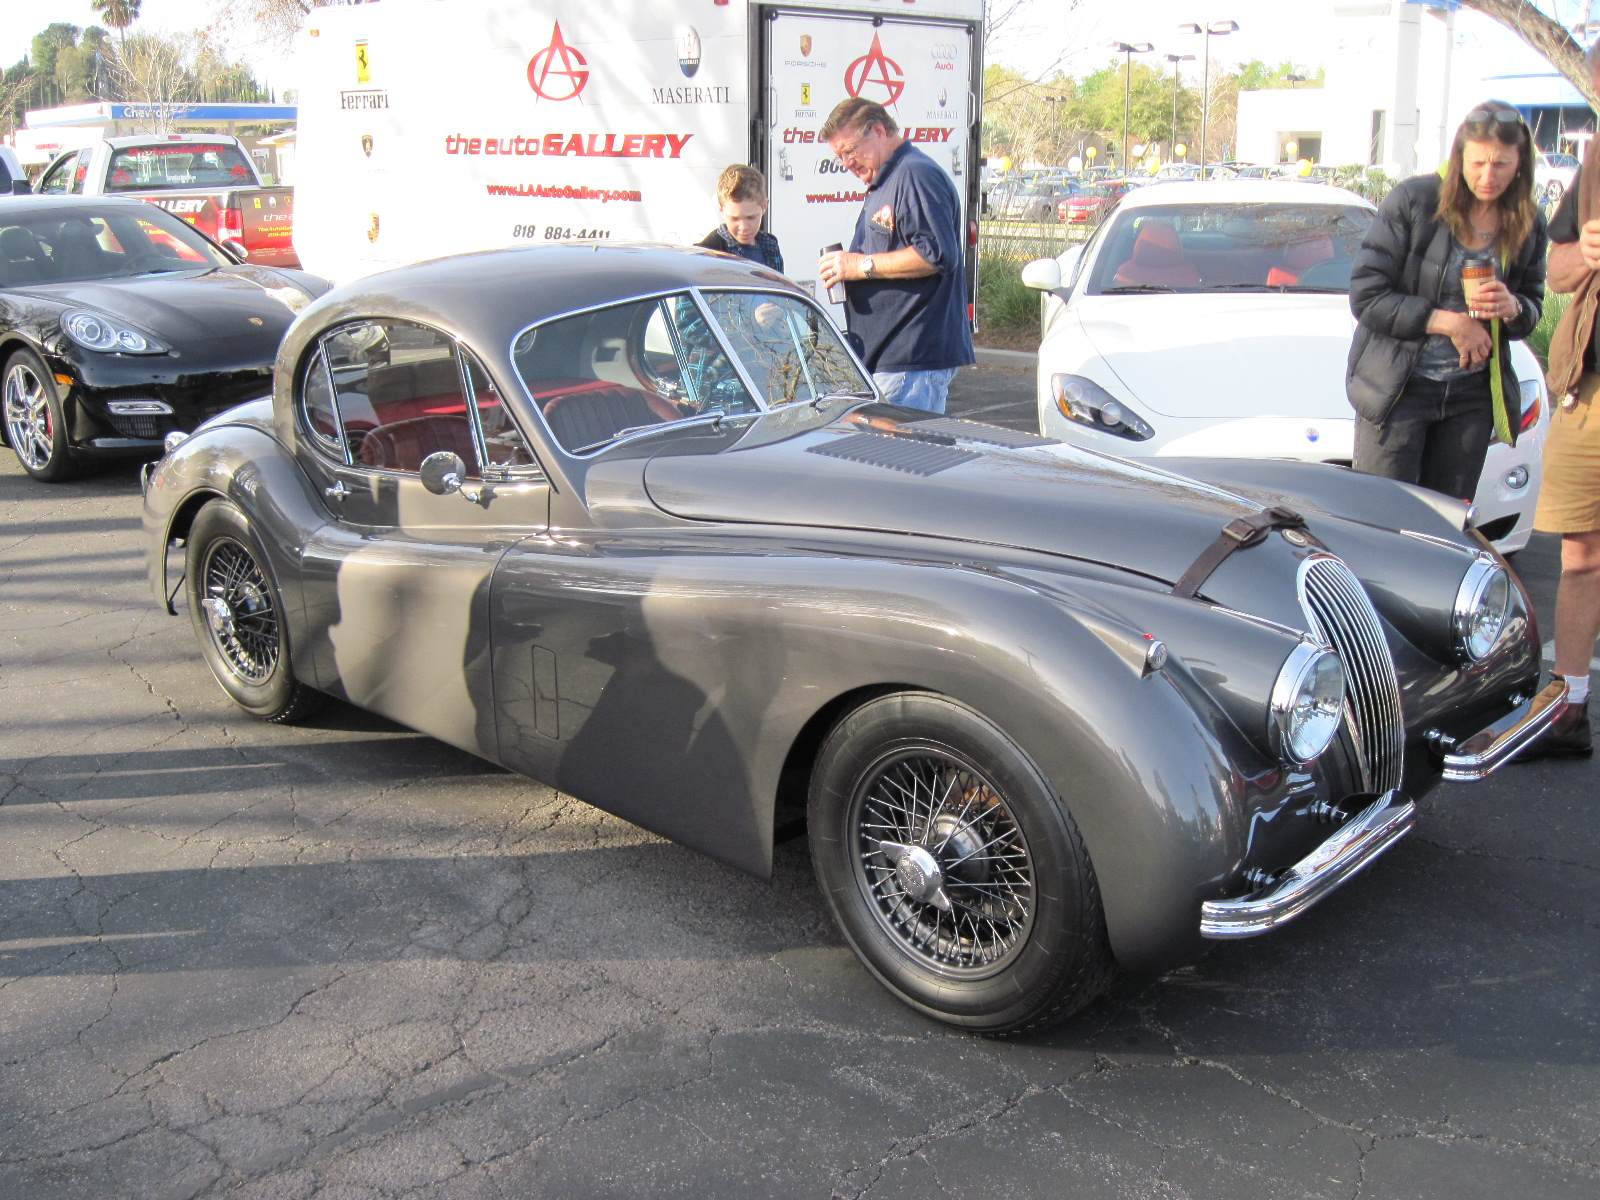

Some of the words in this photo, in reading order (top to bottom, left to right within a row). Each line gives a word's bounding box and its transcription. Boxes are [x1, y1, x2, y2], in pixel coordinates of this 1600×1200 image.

[784, 60, 827, 68] PORSCHE
[934, 61, 954, 71] Audi
[340, 89, 389, 109] Ferrari
[652, 86, 730, 104] MASERATI
[783, 127, 816, 143] the
[903, 128, 955, 143] LLERY
[542, 133, 695, 159] GALLERY
[487, 184, 642, 203] www.LAAutoGallery.com
[513, 224, 536, 239] 818
